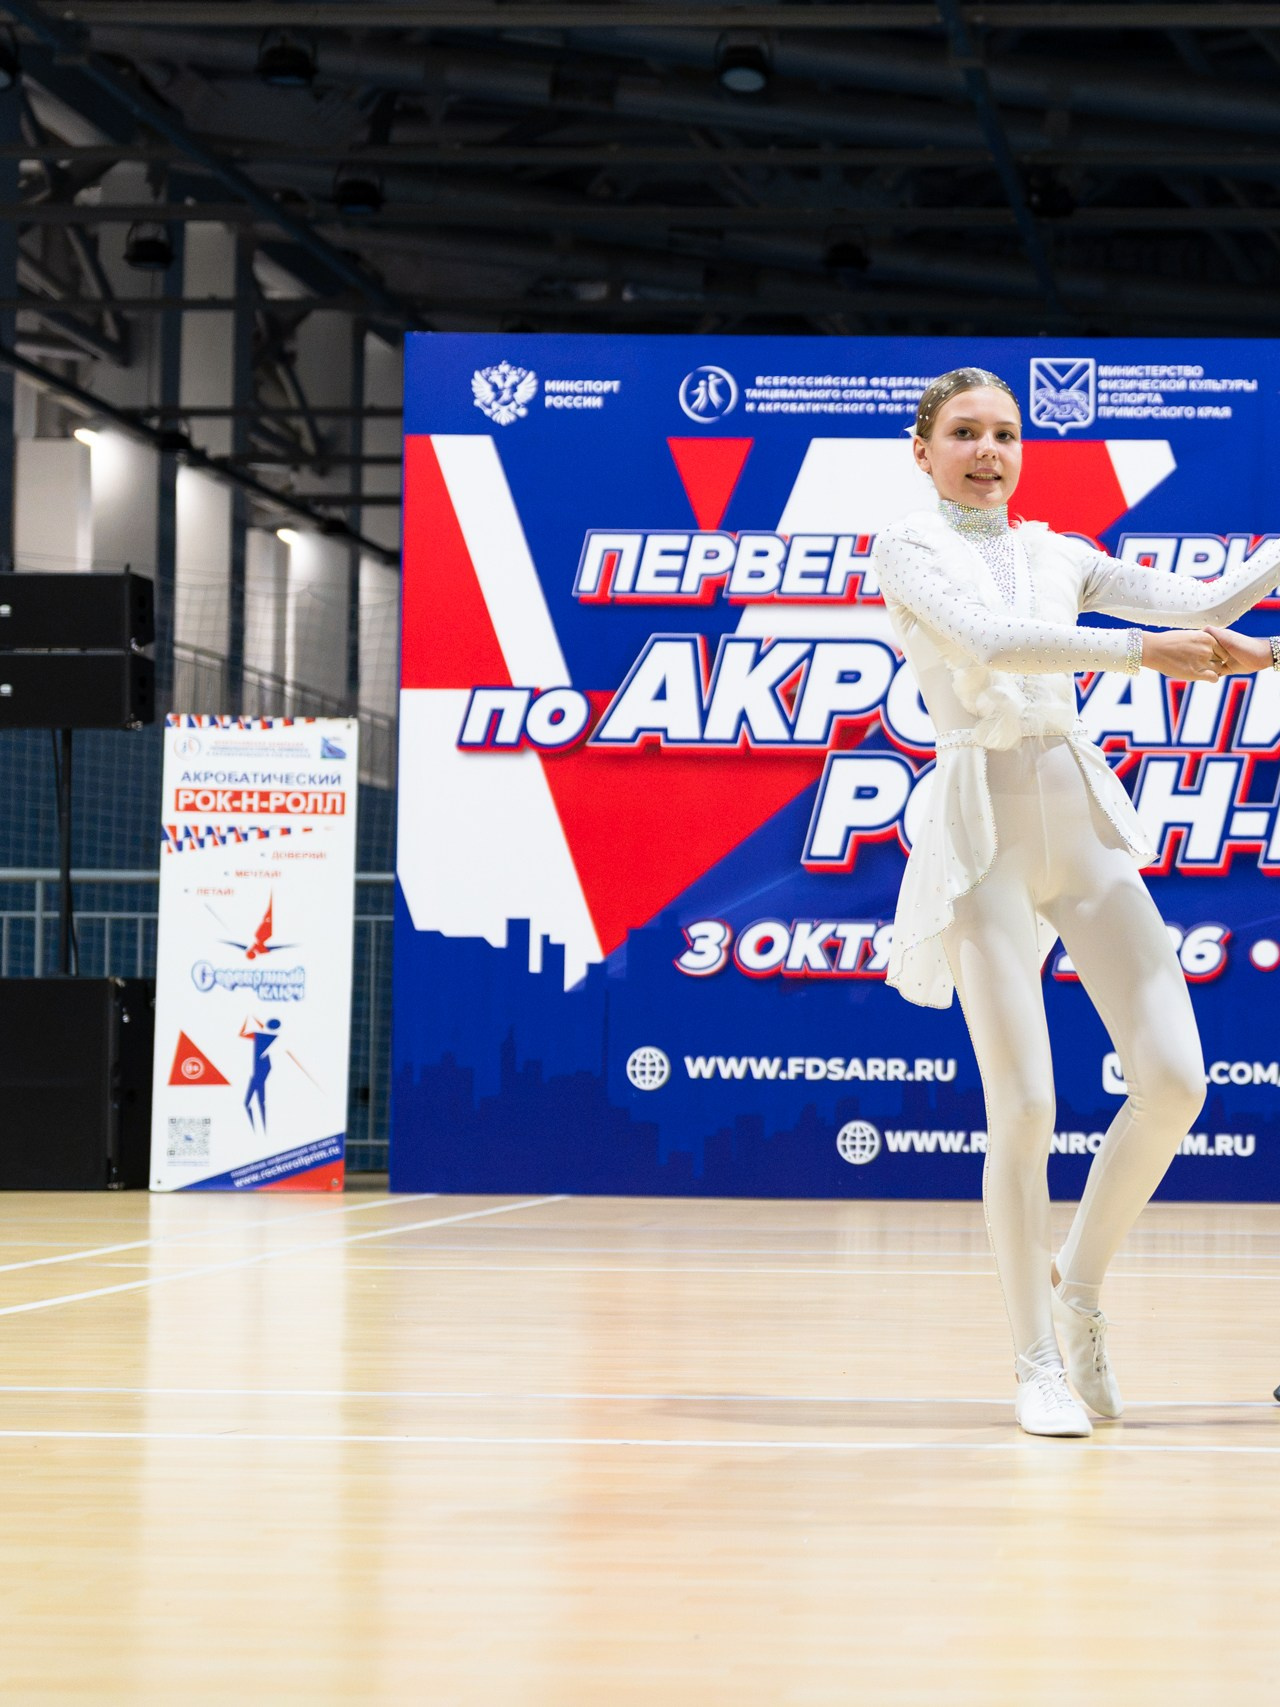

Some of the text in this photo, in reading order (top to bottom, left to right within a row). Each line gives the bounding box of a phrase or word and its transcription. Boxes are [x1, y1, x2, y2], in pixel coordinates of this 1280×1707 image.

[1098, 365, 1204, 378] МИНИСТЕРСТВО
[545, 379, 621, 394] МИНСПОРТ
[755, 375, 935, 388] ВСЕРОССИЙСКАЯ ФЕДЕРАЦ
[1098, 377, 1258, 392] ФИЗИЧЕСКОЙ КУЛЬТУРЫ
[744, 388, 841, 401] ТАНЦЕВАЛЬНОГО
[1098, 392, 1164, 405] И СПОРТА
[545, 395, 603, 409] РОССИИ
[745, 401, 755, 412] И
[757, 402, 877, 414] АКРОБАТИЧЕСКОГО
[1098, 405, 1232, 419] ПРИМОРСКОГО КРАЯ
[181, 769, 342, 785] АКРОБАТИЧЕСКИЙ
[178, 790, 342, 814] РОК-Н-РОЛЛ
[673, 918, 733, 977] 3
[684, 1055, 957, 1083] WWW.FDSARR.RU
